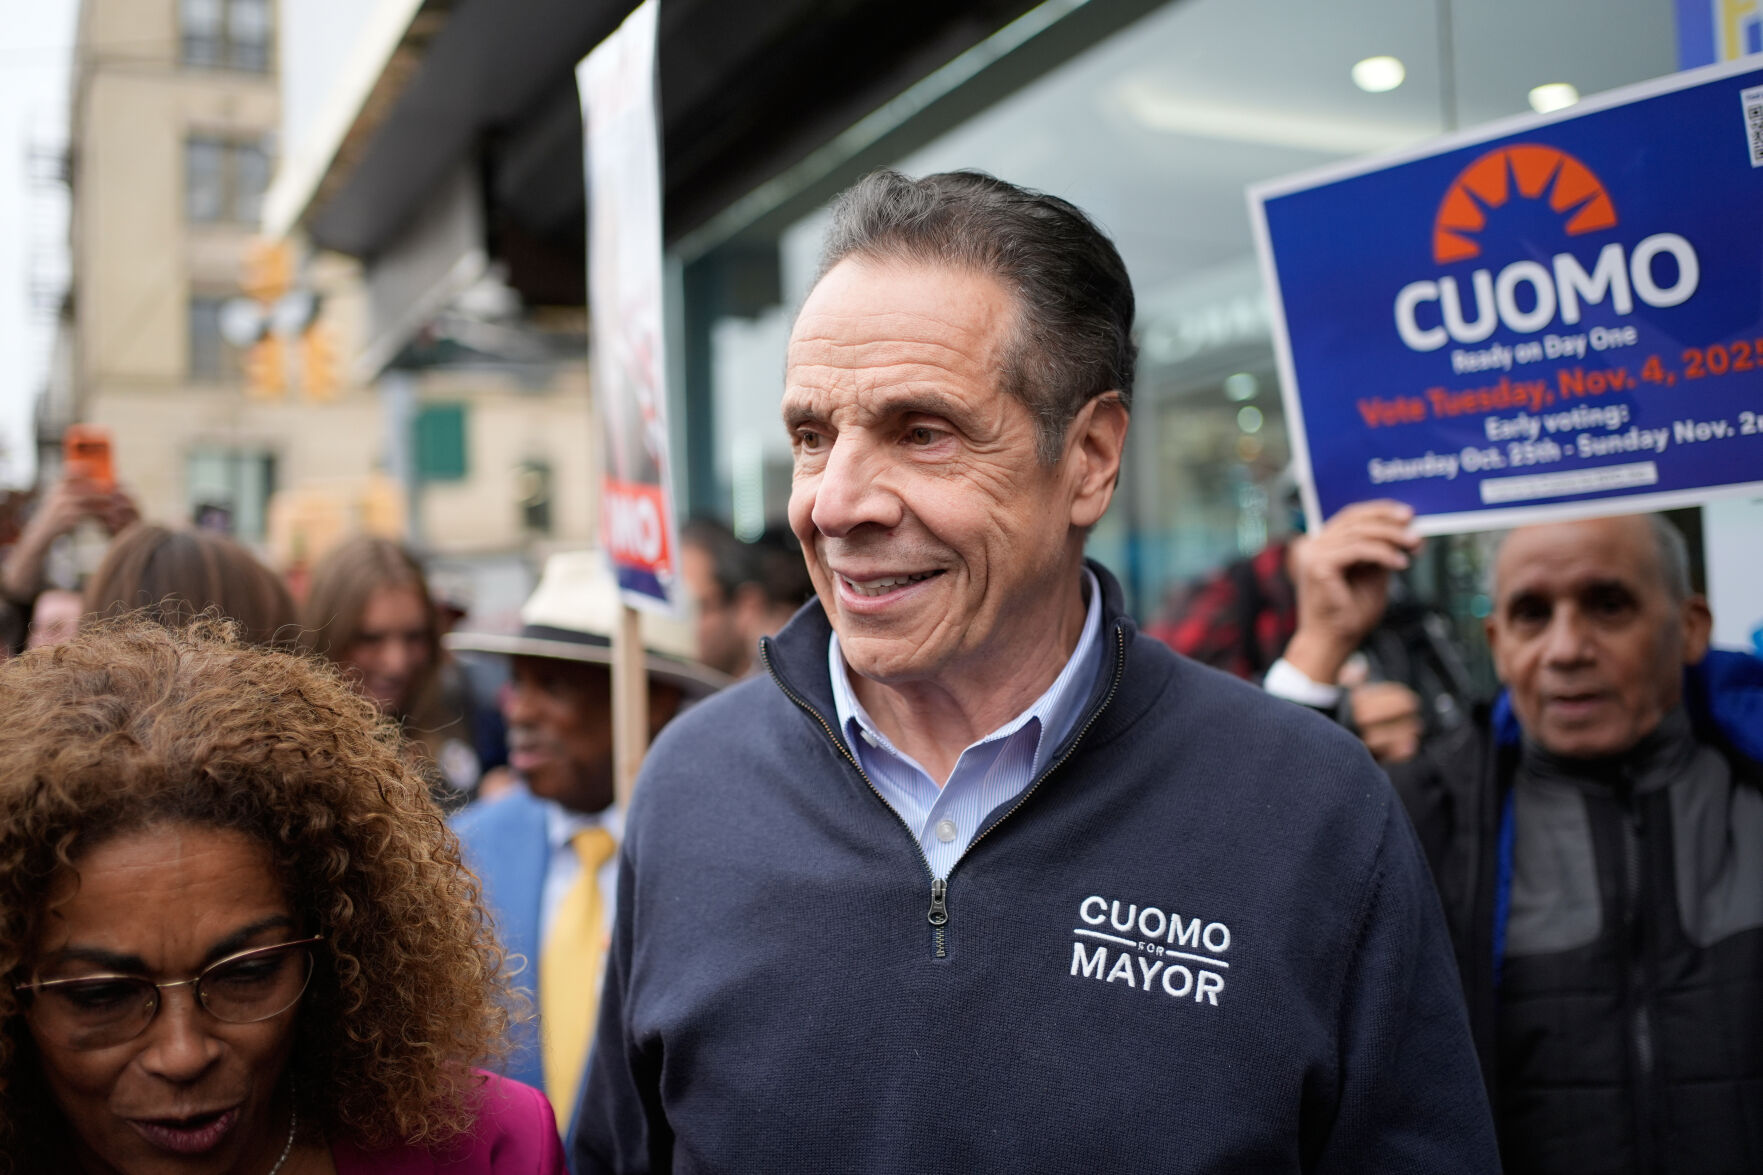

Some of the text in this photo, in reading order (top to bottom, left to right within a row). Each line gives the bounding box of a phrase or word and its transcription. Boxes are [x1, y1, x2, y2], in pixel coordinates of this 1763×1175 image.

[1395, 232, 1698, 351] CUOMO
[1451, 326, 1637, 374] Ready on Day One
[1358, 397, 1425, 427] Vote
[1425, 377, 1554, 418] Tuesday,
[1558, 368, 1636, 398] Nov.
[1642, 354, 1676, 386] 4,
[1368, 450, 1459, 484] Saturday
[1460, 446, 1508, 472] Oct.
[1508, 438, 1561, 467] 25th
[1576, 426, 1669, 458] Sunday
[1673, 420, 1735, 444] Nov.
[1485, 404, 1630, 443] Early voting:
[1080, 896, 1231, 953] CUOMO
[1137, 942, 1165, 957] FOR
[1070, 942, 1225, 1007] MAYOR
